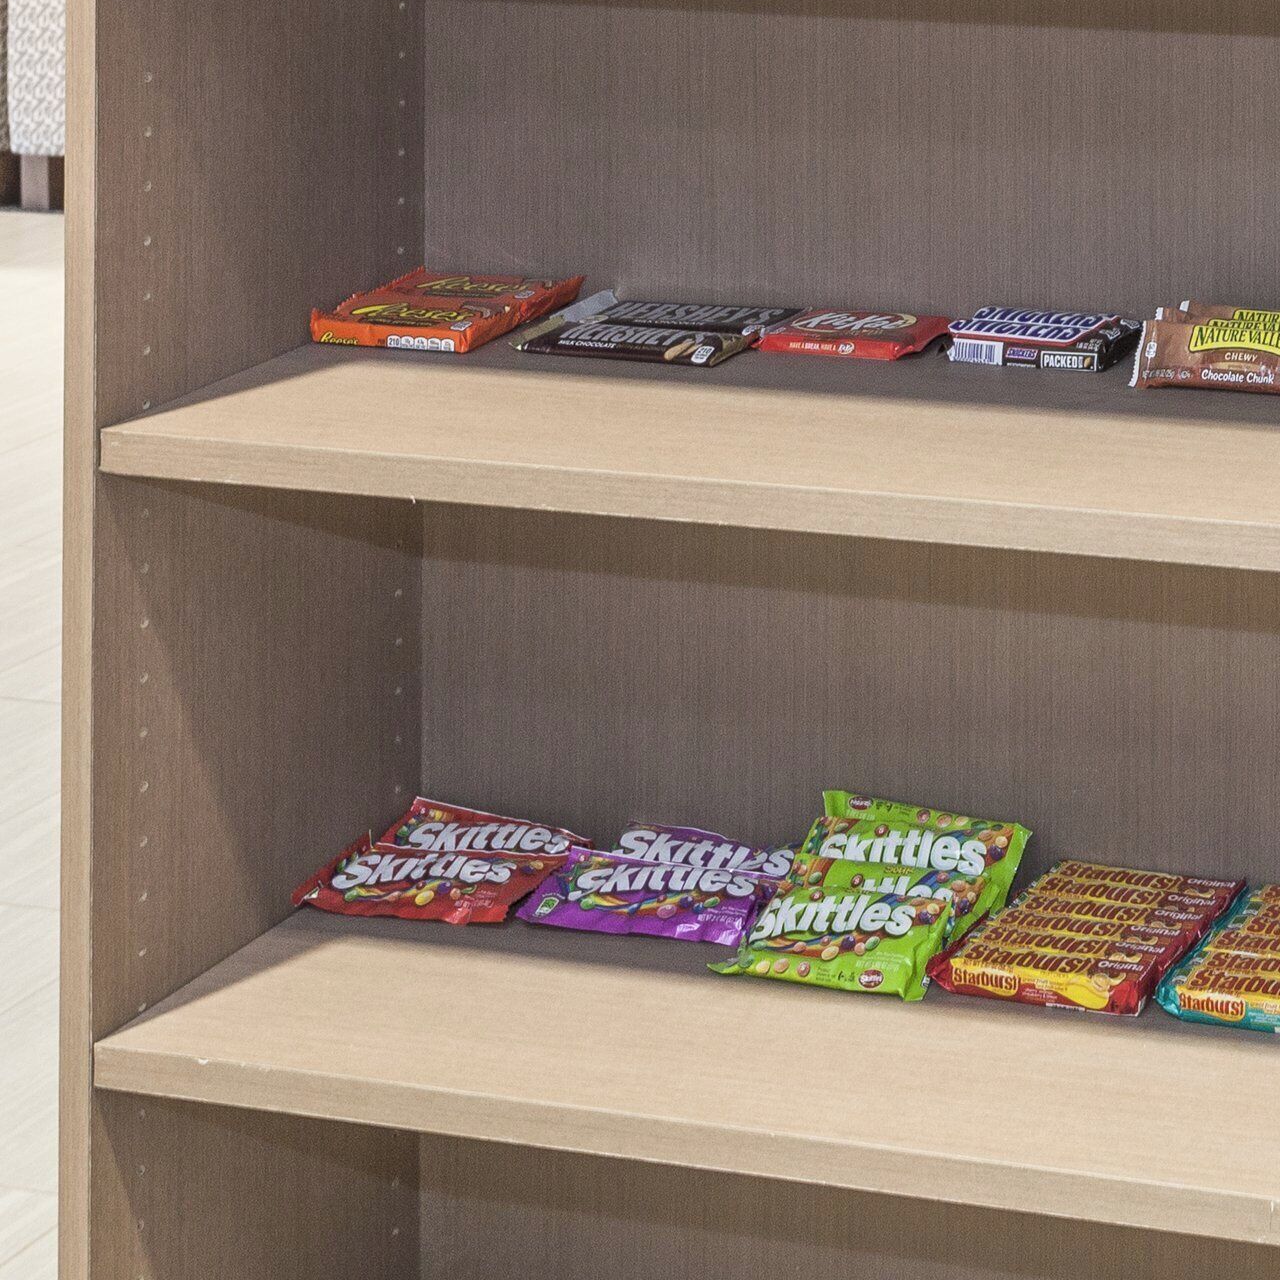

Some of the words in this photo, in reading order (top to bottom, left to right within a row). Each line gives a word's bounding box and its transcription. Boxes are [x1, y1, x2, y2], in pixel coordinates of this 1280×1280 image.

[351, 302, 479, 324] Reese's
[610, 302, 786, 323] HERSHEY'S
[1193, 327, 1247, 348] NATURE
[1043, 354, 1080, 370] PACKED
[1224, 352, 1258, 363] CHEWY
[1201, 369, 1245, 383] Chocolate
[1246, 372, 1275, 385] Chunk
[408, 822, 570, 854] Skittles
[611, 830, 795, 877] Skittles
[819, 830, 987, 876] Skittles
[331, 853, 517, 889] Skittles
[568, 864, 759, 902] Skittles
[750, 890, 916, 942] Skittles
[1026, 893, 1150, 922] Starburst
[1154, 910, 1204, 921] Original
